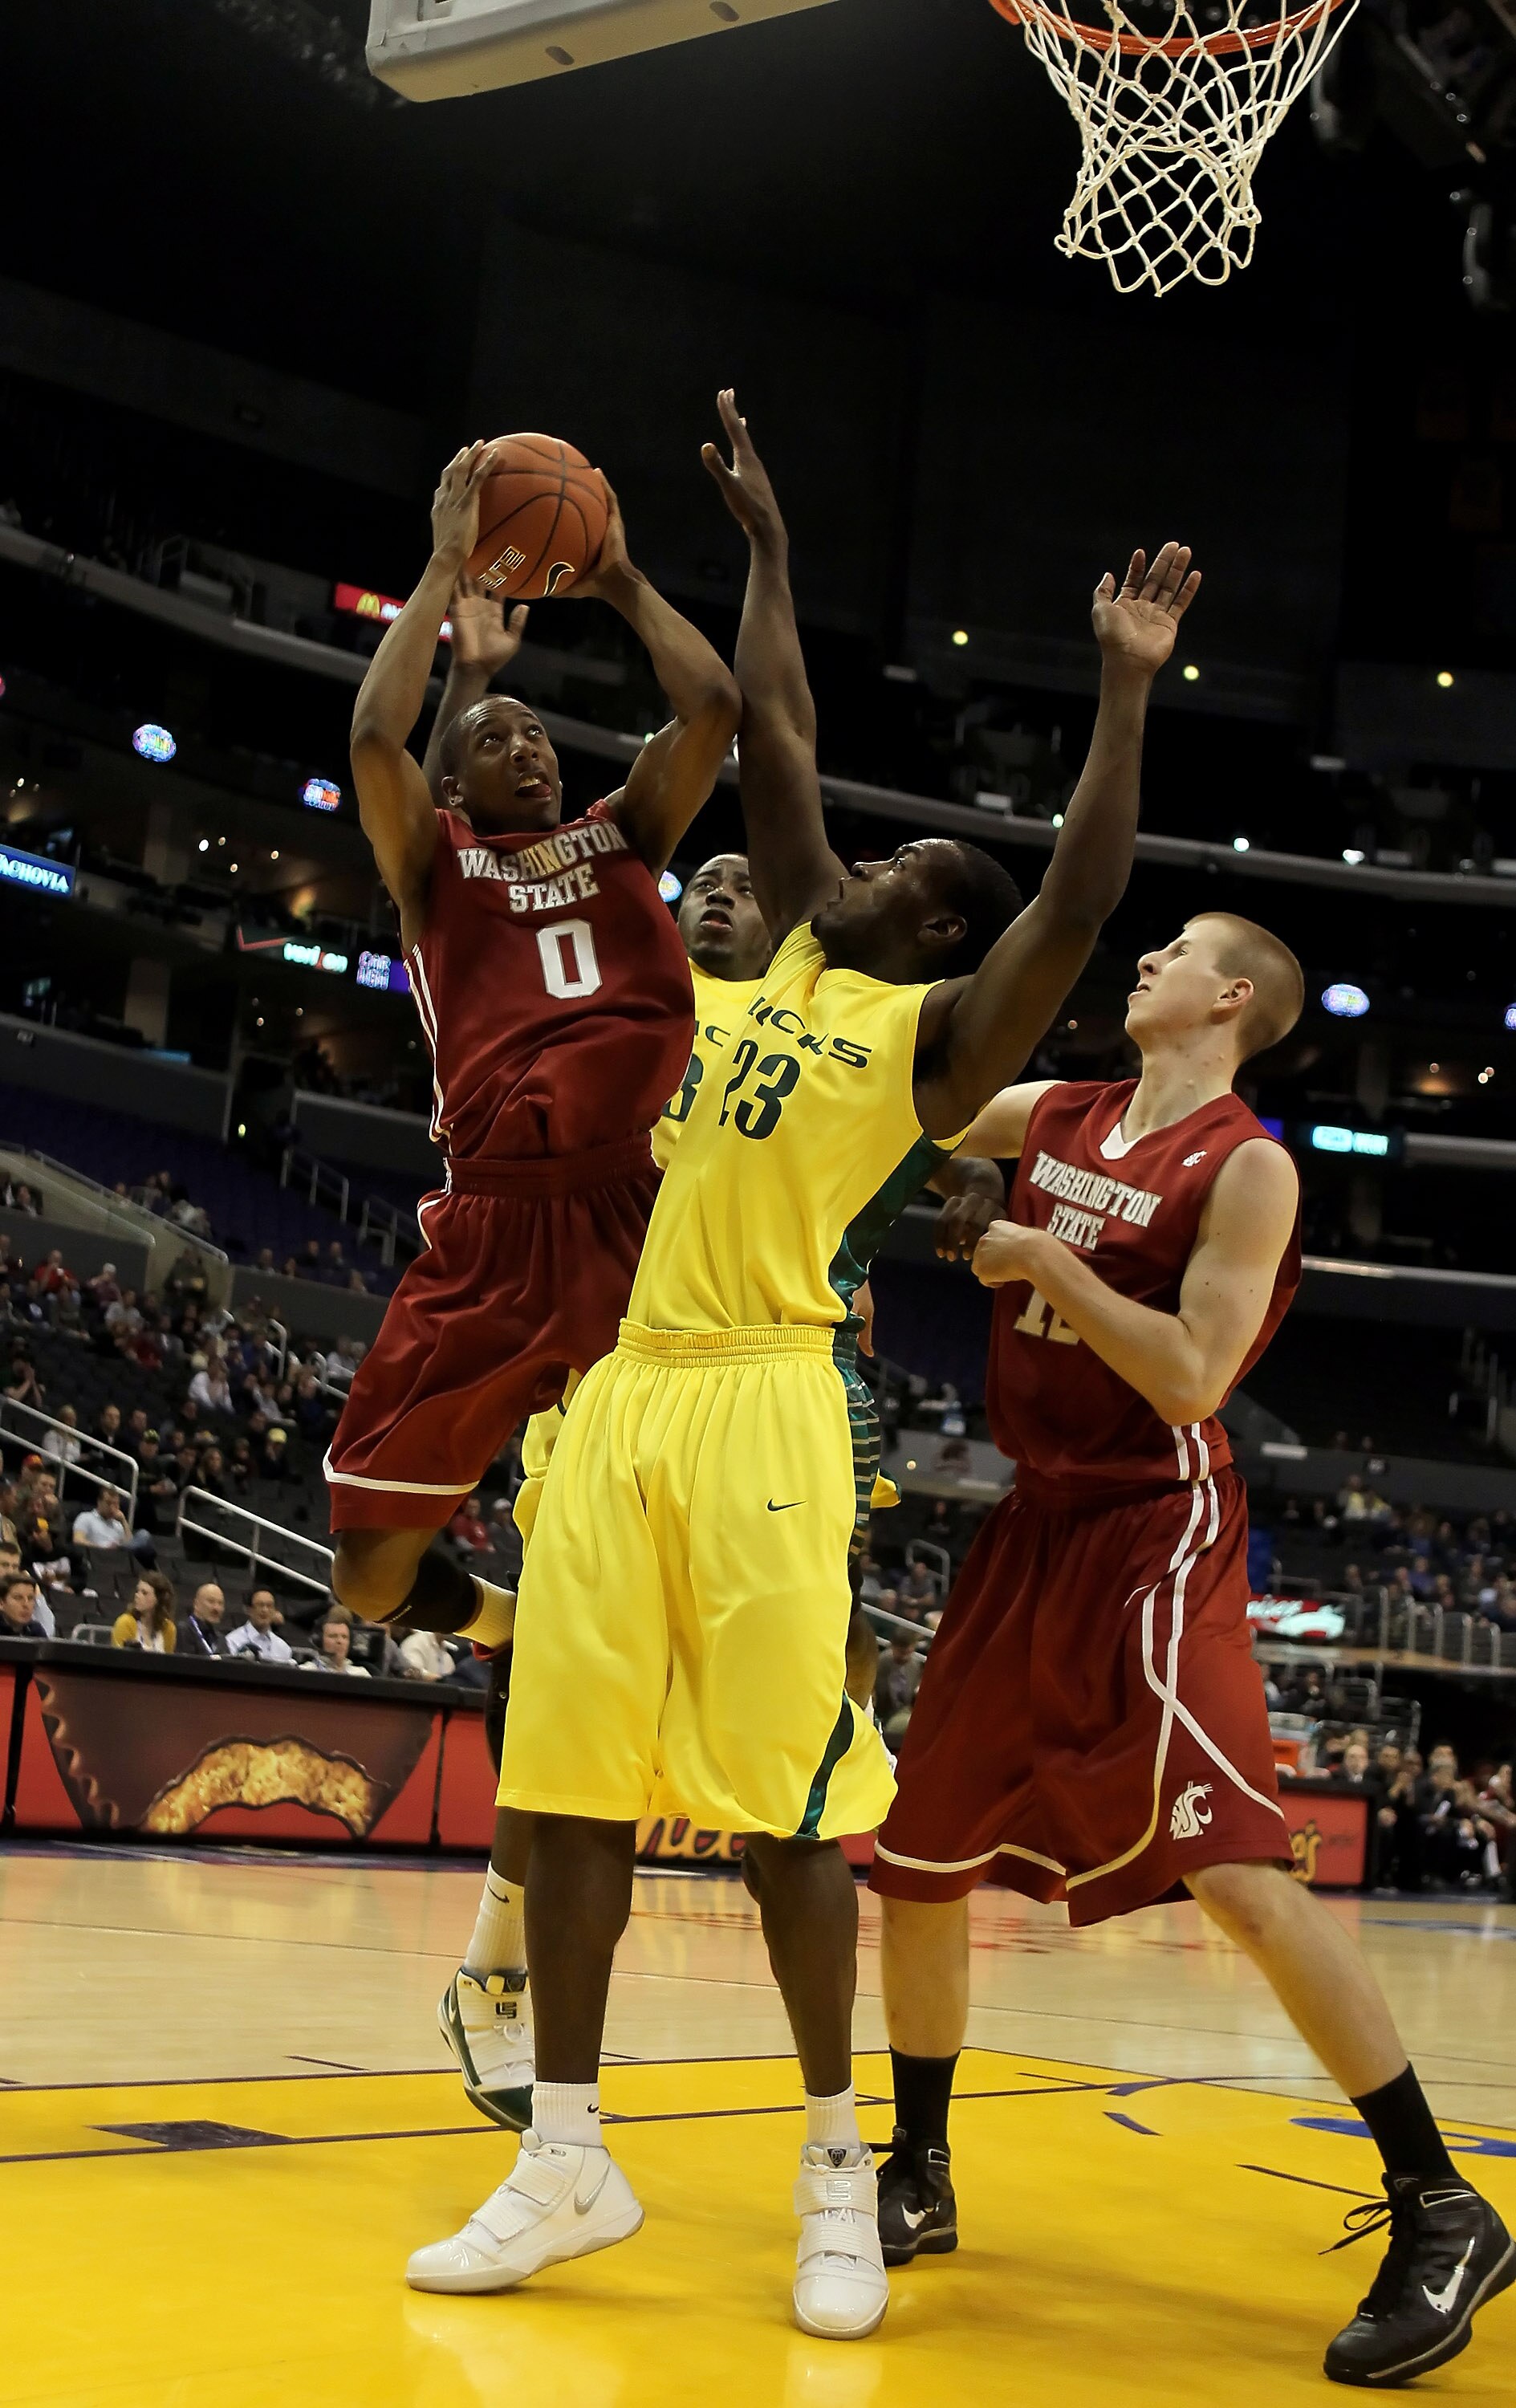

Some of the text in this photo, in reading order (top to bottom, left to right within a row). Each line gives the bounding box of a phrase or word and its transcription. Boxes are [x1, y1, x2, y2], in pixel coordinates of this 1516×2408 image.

[0, 853, 69, 893] ACHOVIA
[457, 821, 629, 882] WASHINGTON
[508, 862, 600, 913] STATE
[535, 918, 603, 999] 0
[718, 1039, 801, 1140] 23
[1028, 1149, 1163, 1227] WASHINGTON
[1047, 1202, 1106, 1251] STATE
[1013, 1288, 1079, 1346] 1
